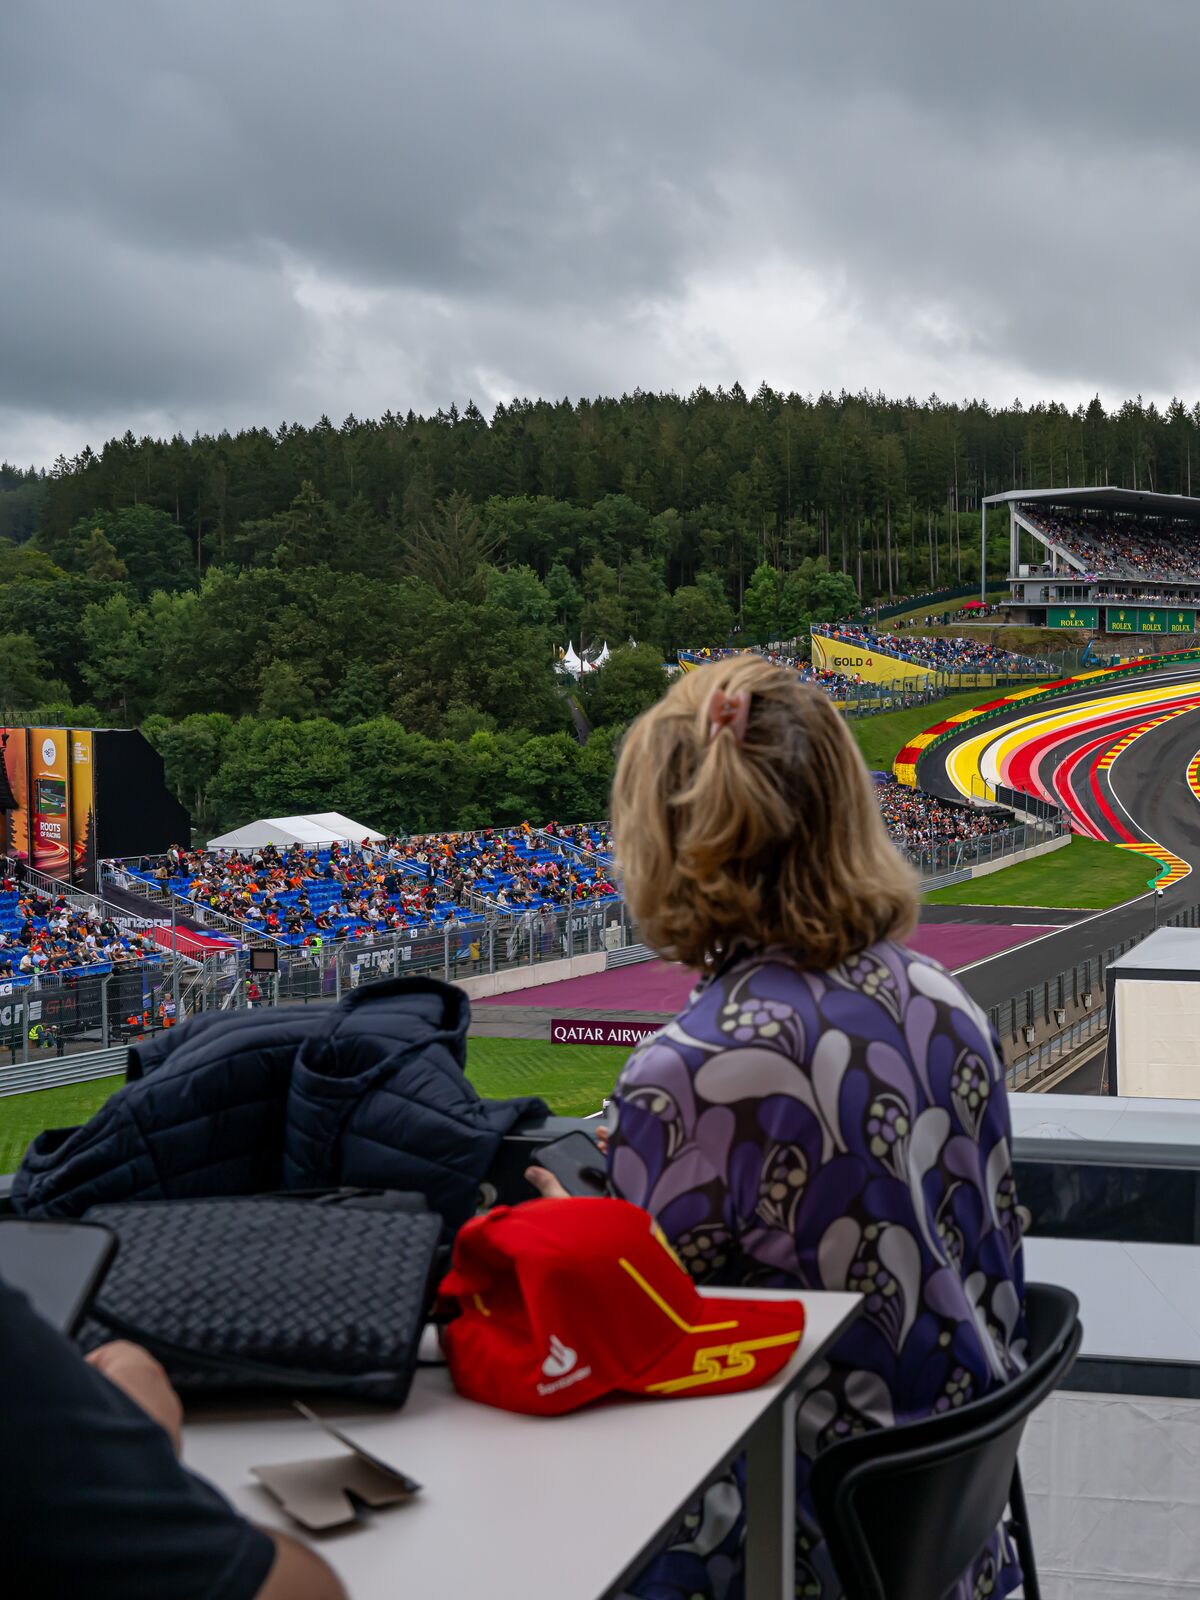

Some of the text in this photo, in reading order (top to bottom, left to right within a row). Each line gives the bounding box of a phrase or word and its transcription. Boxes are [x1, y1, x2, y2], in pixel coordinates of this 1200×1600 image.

[1112, 622, 1132, 630] ROLEX
[1142, 623, 1161, 631] ROLEX
[834, 657, 873, 667] GOLD 4
[40, 822, 61, 832] ROOTS
[3, 985, 9, 994] C
[554, 1026, 604, 1042] QATAR
[692, 1344, 756, 1382] 55
